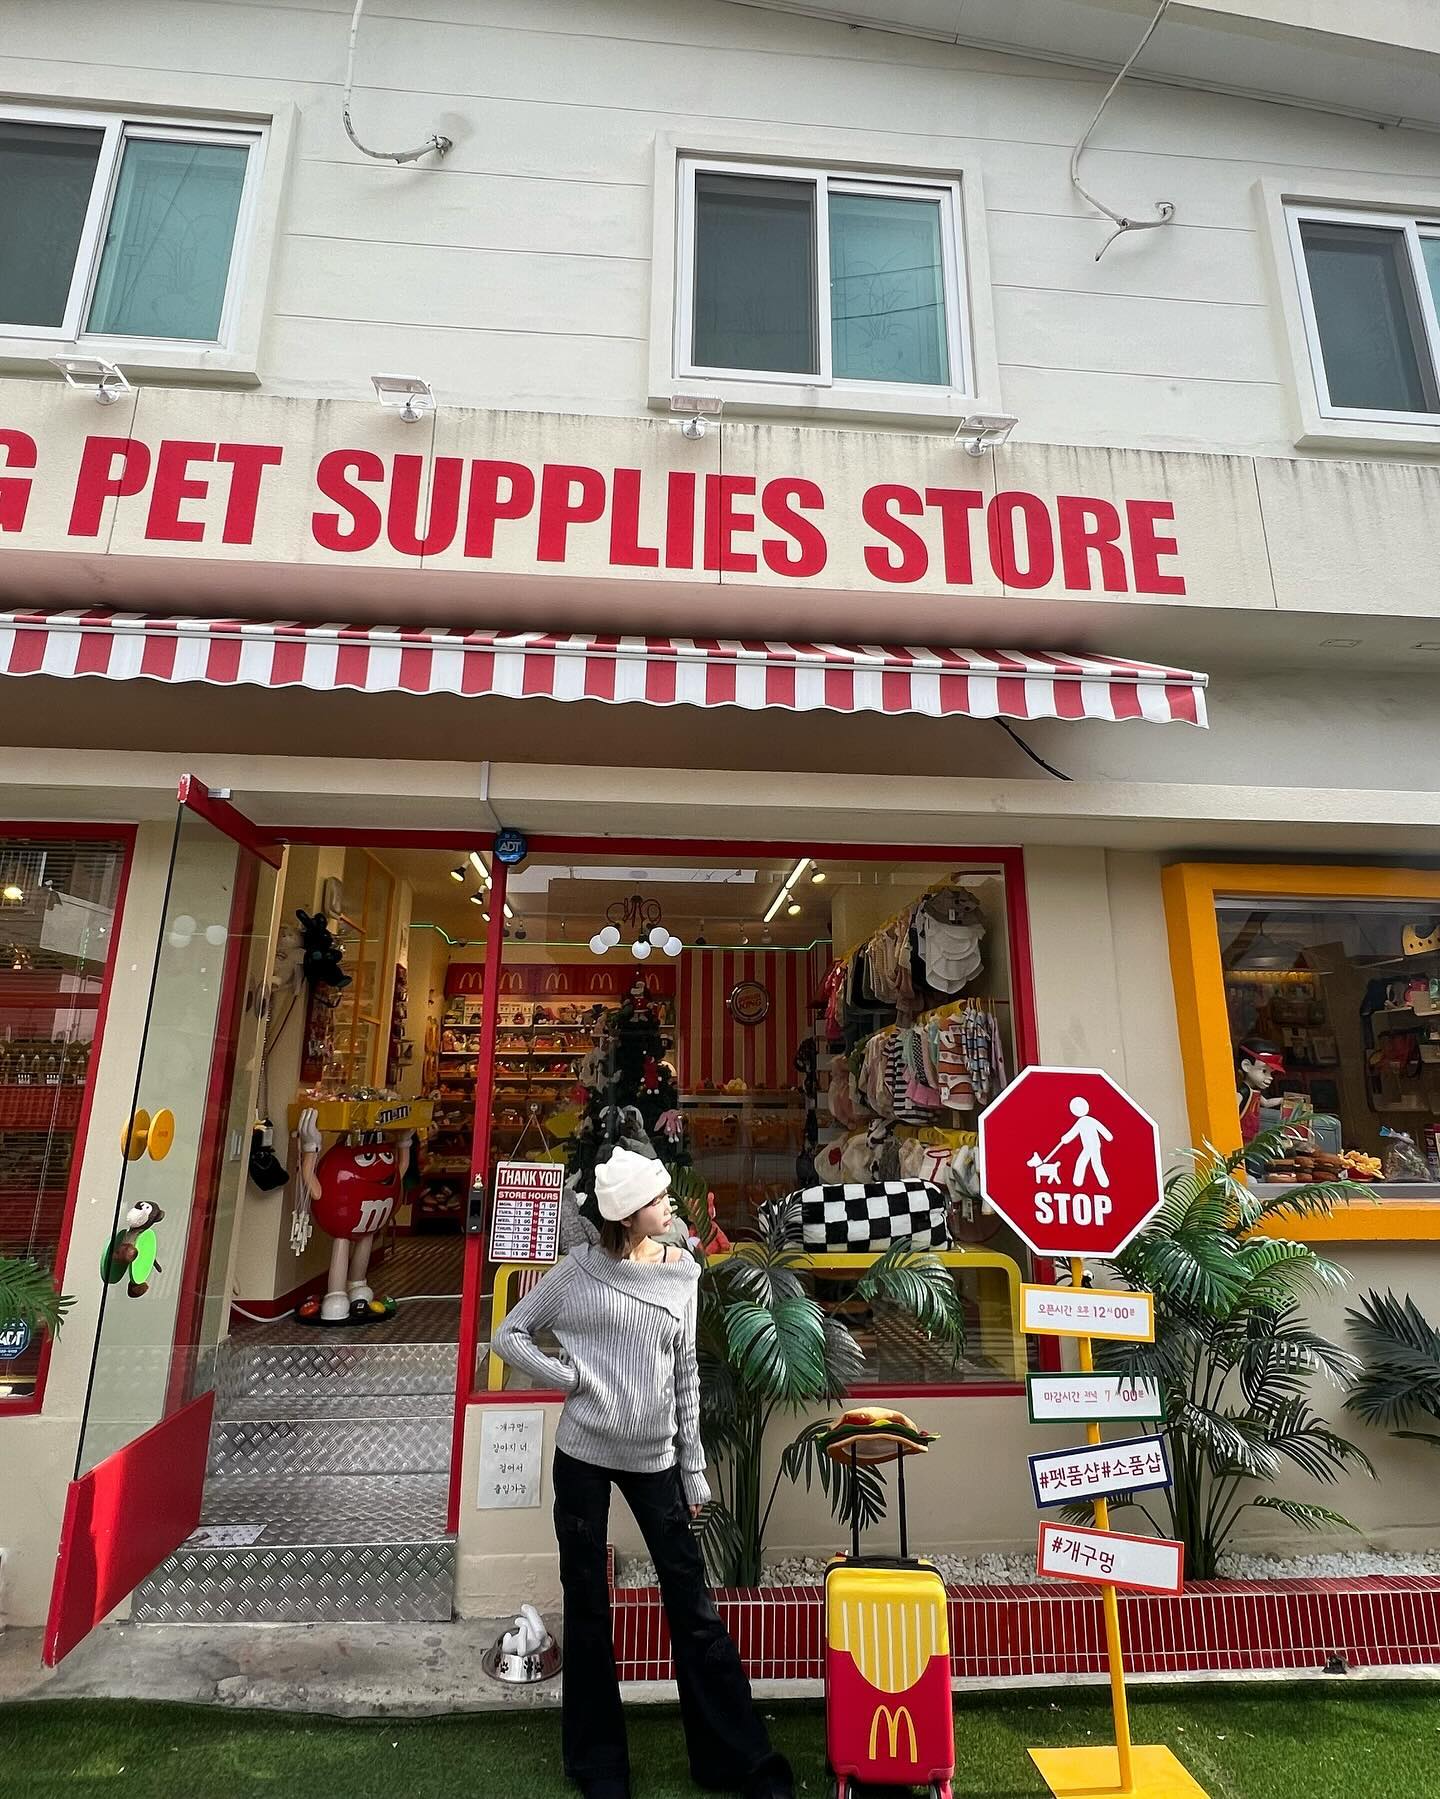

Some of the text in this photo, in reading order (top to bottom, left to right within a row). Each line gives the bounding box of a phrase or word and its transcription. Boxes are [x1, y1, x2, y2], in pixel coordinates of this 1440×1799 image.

[67, 434, 283, 545] PET
[312, 448, 828, 579] SUPPLIES
[862, 483, 1188, 596] STORE
[498, 841, 522, 852] ADT
[500, 1169, 561, 1187] THANK YOU
[498, 1191, 559, 1201] STORE HOURS
[1034, 1191, 1113, 1226] STOP
[1038, 1303, 1072, 1316] 오픈시간
[1077, 1305, 1090, 1314] 오후
[1043, 1391, 1080, 1404] 마감시간
[1084, 1390, 1098, 1399] 저녁
[493, 1443, 516, 1453] 강아지
[499, 1463, 523, 1474] 걸어서
[494, 1484, 527, 1495] 출입가능
[1051, 1536, 1115, 1574] #개구멍
